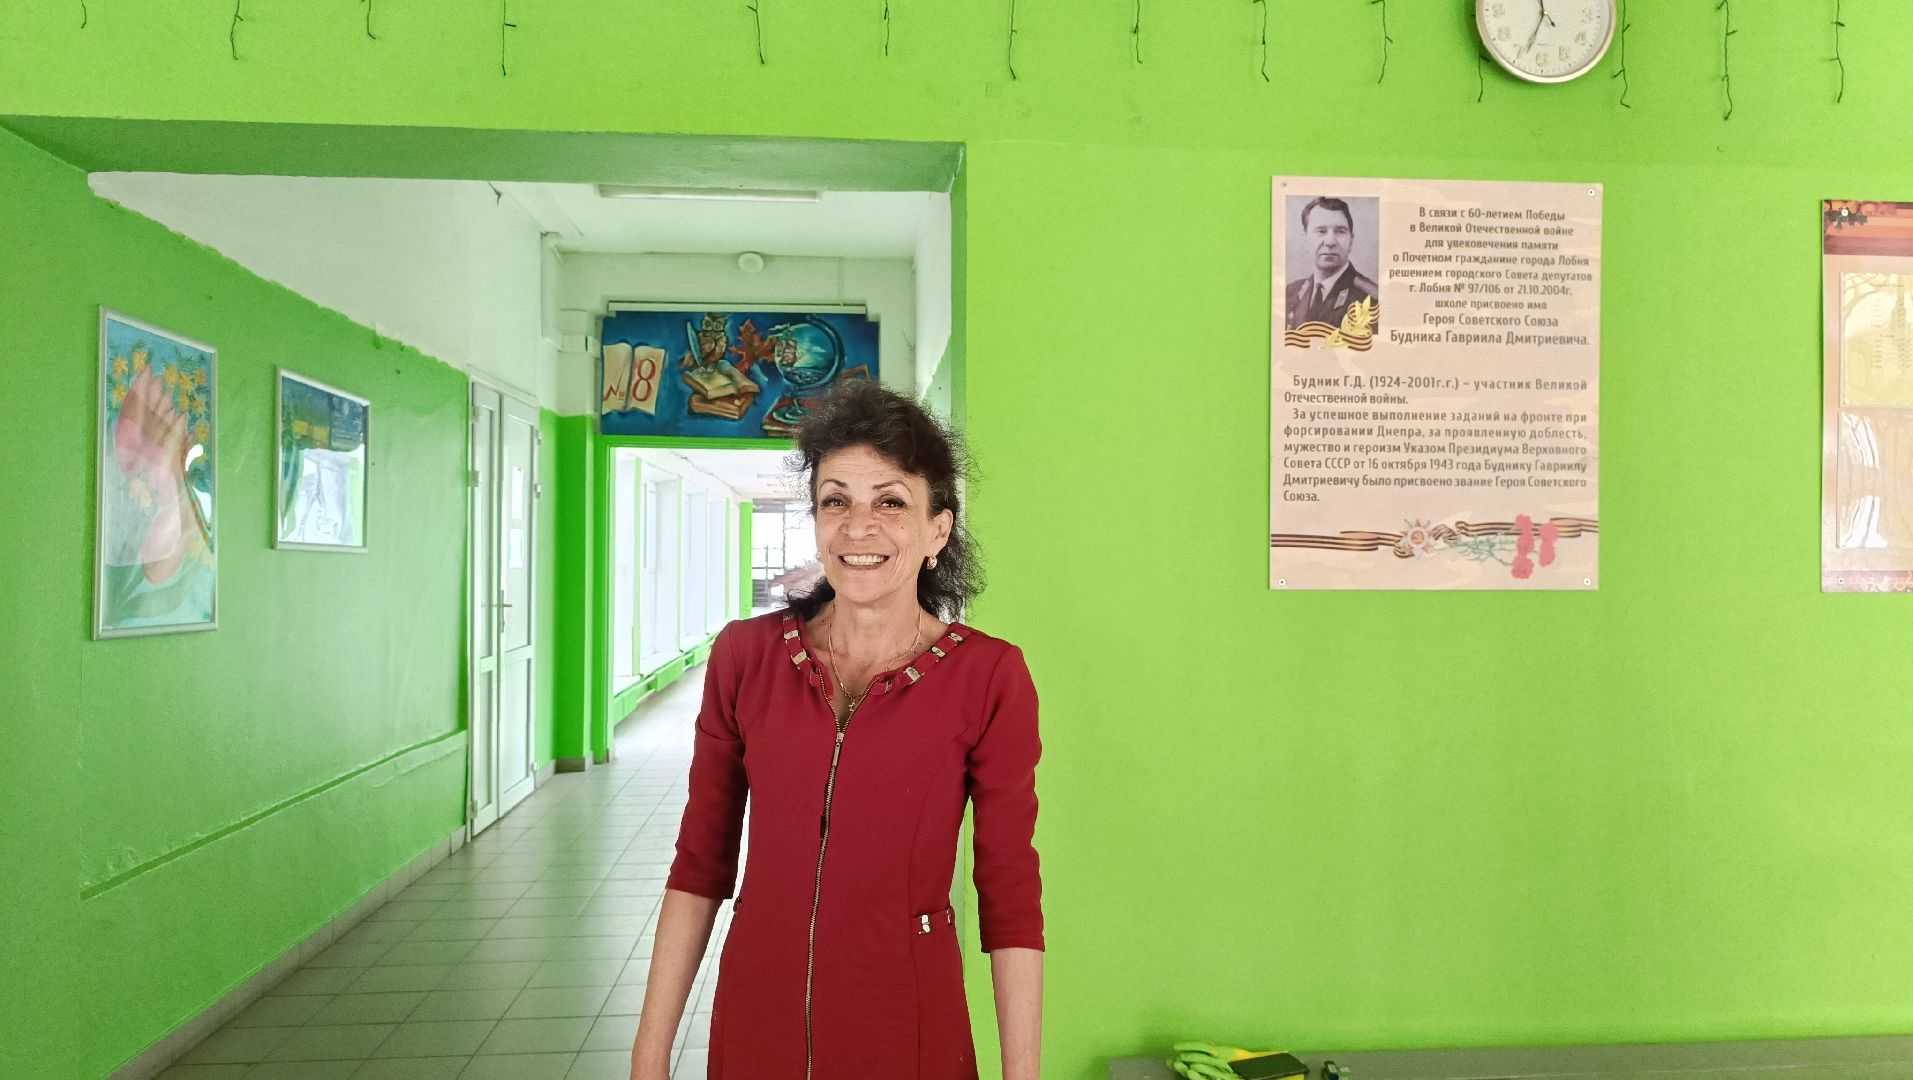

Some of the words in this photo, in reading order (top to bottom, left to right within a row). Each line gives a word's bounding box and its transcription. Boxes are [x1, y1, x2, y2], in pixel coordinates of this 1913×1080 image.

[1419, 207, 1426, 217] В
[1429, 209, 1457, 218] связи
[1461, 210, 1466, 218] с
[1468, 208, 1523, 221] 60-летием
[1525, 210, 1565, 221] Победы
[1410, 224, 1416, 233] в
[1419, 222, 1462, 234] Великой
[1465, 224, 1541, 235] Отечественной
[1544, 226, 1574, 236] войне
[1425, 240, 1444, 250] для
[1447, 240, 1518, 251] увековечения
[1521, 242, 1558, 250] памяти
[1393, 254, 1399, 262] о
[1402, 252, 1452, 264] Почетном
[1455, 255, 1517, 267] гражданине
[1520, 256, 1555, 267] города
[1558, 255, 1589, 266] Лобня
[1389, 269, 1442, 280] решением
[1445, 270, 1502, 281] городского
[1505, 269, 1538, 280] Совета
[1541, 272, 1593, 283] депутатов
[1409, 285, 1416, 293] г.
[1419, 282, 1451, 293] Лобня
[1454, 283, 1465, 293] №
[1468, 283, 1500, 295] 97/106
[1503, 286, 1515, 294] от
[1518, 284, 1573, 296] 21.10.2004г.
[1435, 300, 1467, 309] школе
[1470, 300, 1524, 311] присвоено
[1527, 301, 1547, 310] имя
[1423, 313, 1455, 328] Героя
[1458, 314, 1520, 327] Советского
[1524, 316, 1558, 327] Союза
[1390, 330, 1441, 344] Будника
[1445, 330, 1501, 344] Гавриила
[1505, 332, 1591, 347] Дмитриевича.
[631, 358, 656, 402] 8
[1293, 375, 1340, 389] Будник
[1343, 376, 1366, 389] Г.Д.
[1369, 376, 1459, 390] (1924-2001г.г.)
[1474, 380, 1531, 391] участник
[1535, 378, 1587, 390] Великой
[1284, 391, 1367, 404] Отечественной
[1369, 393, 1409, 404] войны.
[1293, 408, 1306, 420] За
[1309, 410, 1369, 423] успешное
[1372, 411, 1447, 421] выполнение
[1450, 410, 1500, 423] заданий
[1503, 413, 1517, 422] на
[1520, 412, 1562, 424] фронте
[1565, 413, 1587, 425] при
[1284, 425, 1373, 438] форсировании
[1376, 426, 1425, 439] Днепра,
[1428, 428, 1441, 438] за
[1445, 428, 1526, 441] проявленную
[1529, 427, 1587, 441] доблесть,
[1284, 444, 1341, 454] мужество
[1343, 444, 1350, 453] и
[1353, 444, 1401, 455] героизм
[1404, 442, 1446, 454] Указом
[1449, 443, 1519, 456] Президиума
[1522, 444, 1587, 456] Верховного
[1284, 457, 1322, 470] Совета
[1325, 458, 1351, 469] СССР
[1353, 460, 1365, 469] от
[1368, 458, 1379, 469] 16
[1381, 459, 1427, 472] октября
[1430, 458, 1453, 470] 1943
[1456, 461, 1481, 472] года
[1484, 459, 1532, 473] Буднику
[1535, 460, 1587, 473] Гавриилу
[1283, 474, 1359, 488] Дмитриевичу
[1362, 475, 1392, 486] было
[1393, 477, 1452, 489] присвоено
[1454, 478, 1493, 487] звание
[1495, 476, 1525, 489] Героя
[1527, 476, 1587, 488] Советского
[1283, 490, 1320, 502] Союза.
